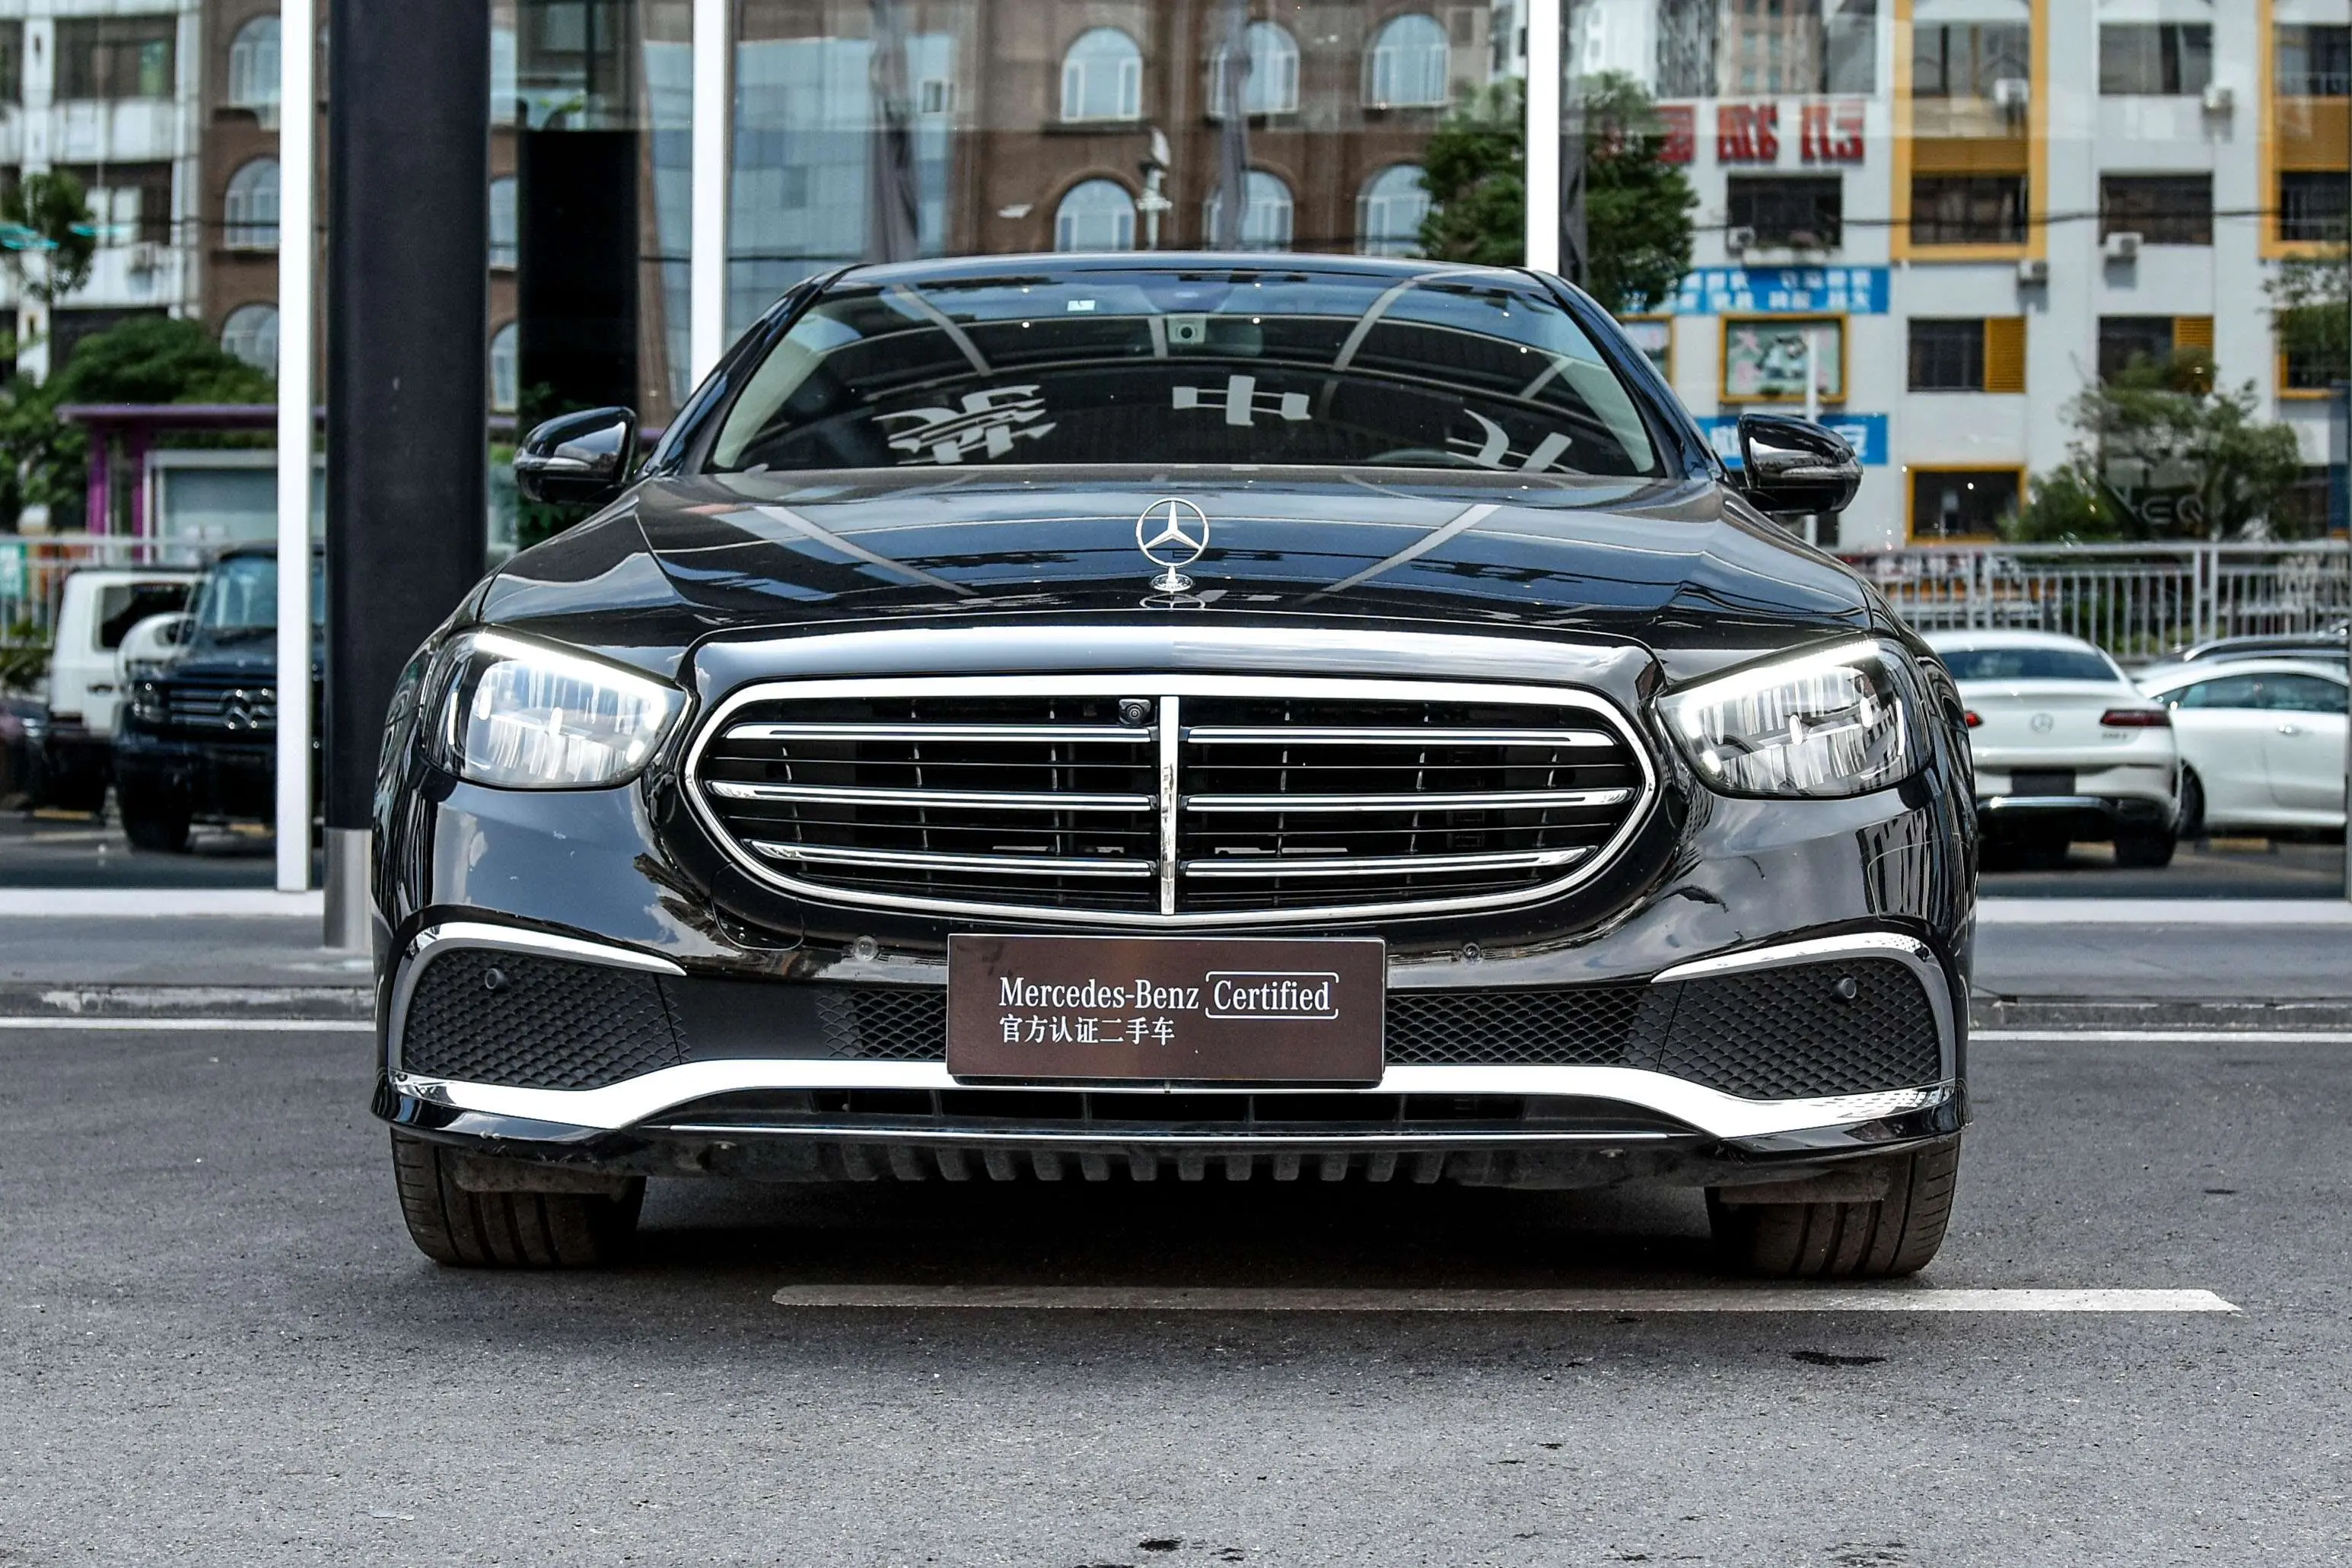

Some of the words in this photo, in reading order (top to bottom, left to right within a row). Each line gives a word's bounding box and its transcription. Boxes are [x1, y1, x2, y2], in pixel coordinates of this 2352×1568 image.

[998, 976, 1200, 1010] Mercedes-Benz
[1213, 980, 1331, 1012] Certified
[998, 1013, 1176, 1046] 官方认证二手车
